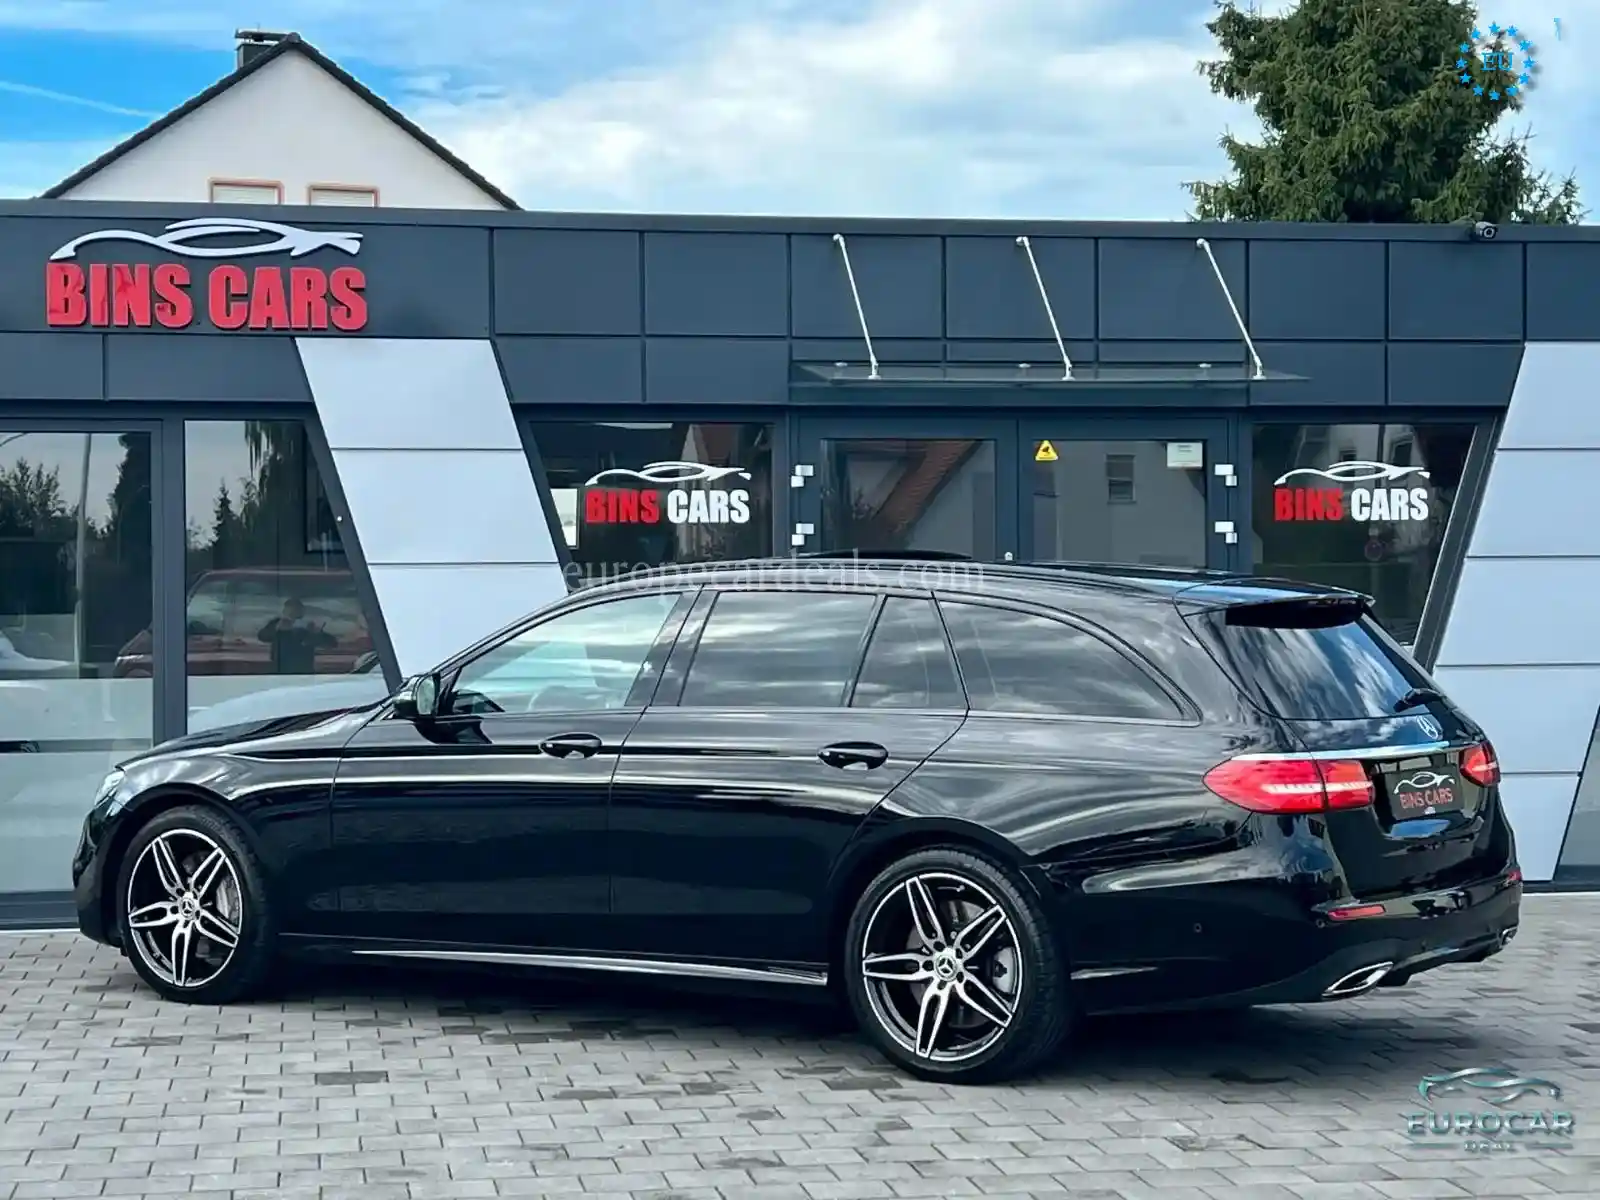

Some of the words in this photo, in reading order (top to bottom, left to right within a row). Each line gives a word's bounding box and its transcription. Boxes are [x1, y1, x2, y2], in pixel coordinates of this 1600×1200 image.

[46, 262, 194, 329] BINS
[208, 265, 369, 331] CARS
[584, 488, 661, 524] BINS
[667, 489, 750, 524] CARS
[1274, 487, 1345, 521] BINS
[1351, 487, 1429, 522] CARS
